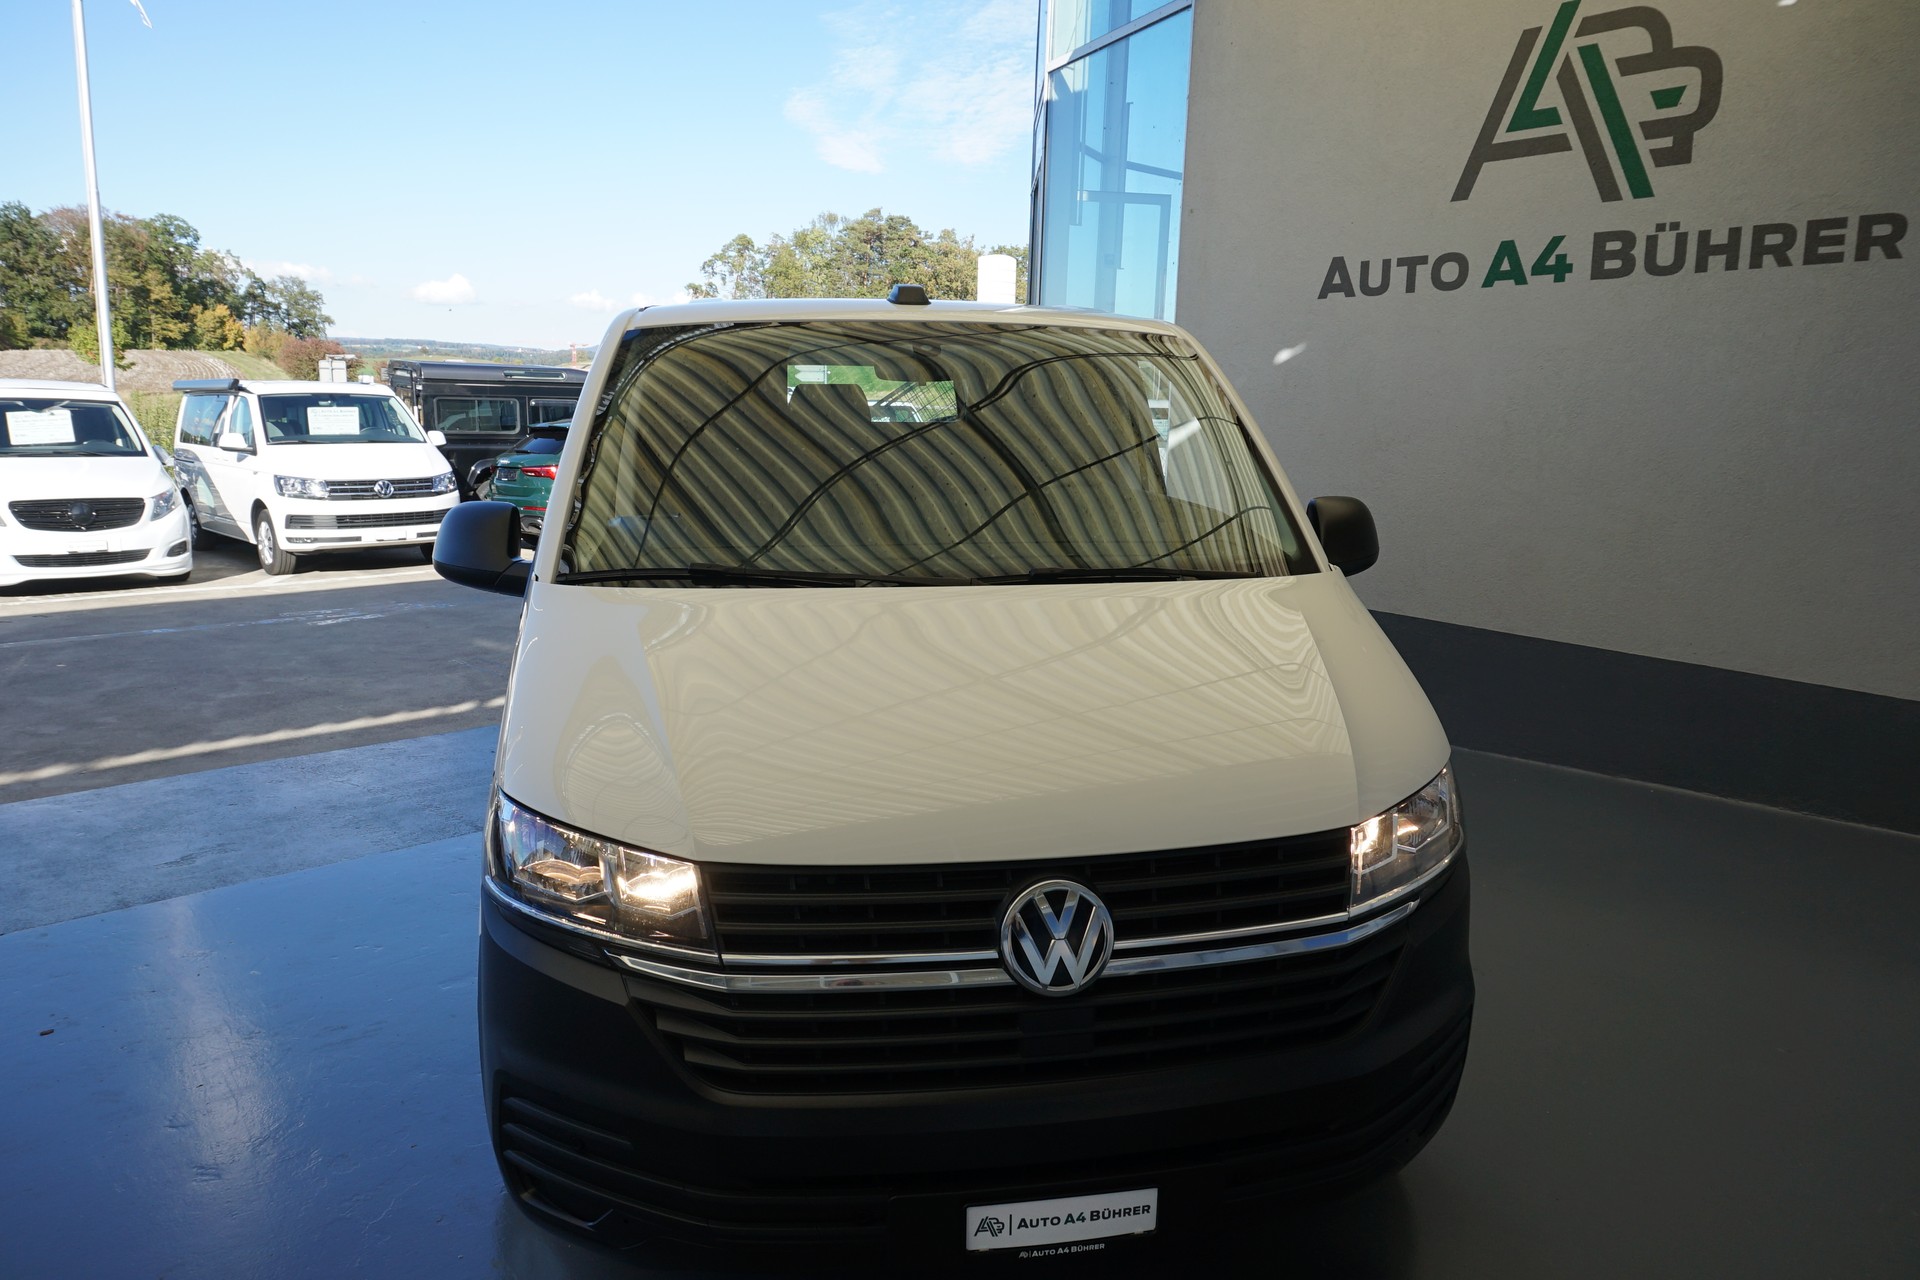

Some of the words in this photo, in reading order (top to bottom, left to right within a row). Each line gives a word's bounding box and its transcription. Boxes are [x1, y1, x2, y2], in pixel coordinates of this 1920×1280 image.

[1317, 252, 1470, 300] AUTO
[1481, 235, 1573, 288] A4
[1590, 212, 1909, 281] BÜHRER
[1017, 1217, 1061, 1231] AUTO
[1064, 1212, 1087, 1226] A4
[1090, 1205, 1151, 1221] BÜHRER
[1032, 1249, 1056, 1258] AUTO
[1057, 1247, 1070, 1255] A4
